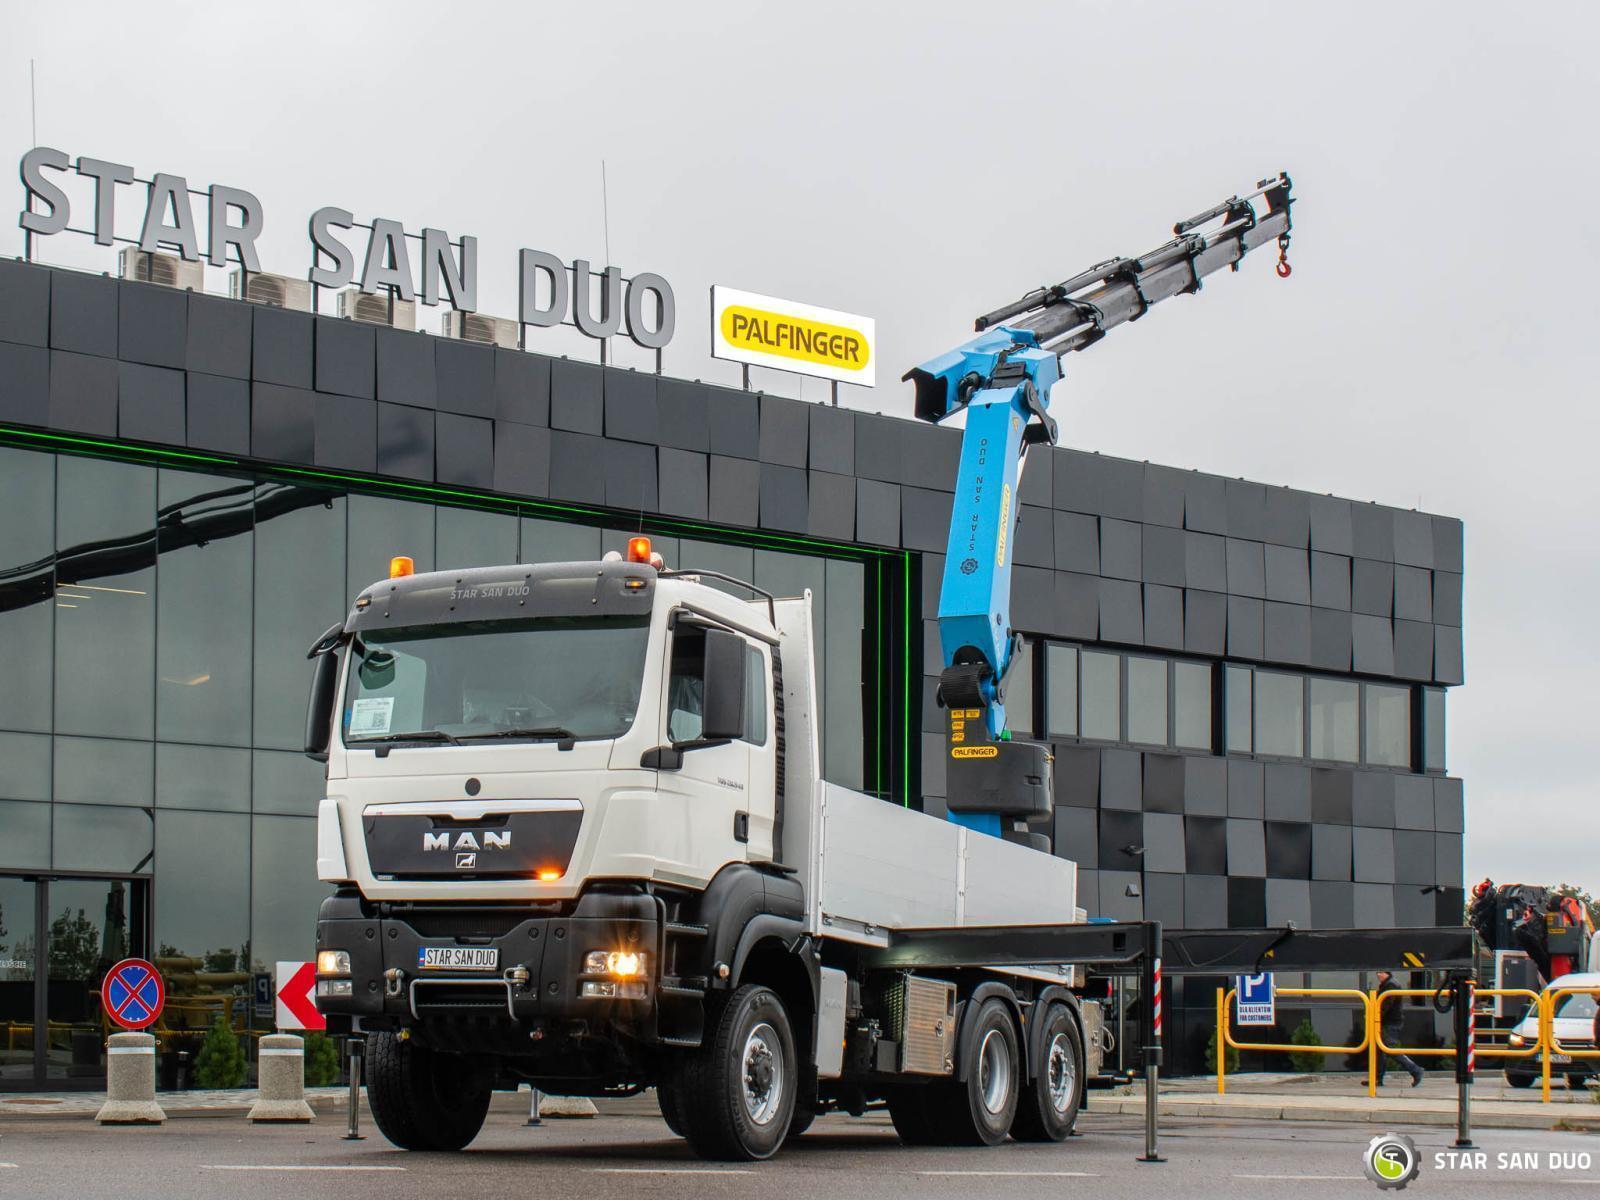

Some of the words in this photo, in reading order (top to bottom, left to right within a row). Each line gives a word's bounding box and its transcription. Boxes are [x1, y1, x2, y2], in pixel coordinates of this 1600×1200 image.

[20, 147, 264, 273] STAR
[309, 206, 477, 312] SAN
[519, 247, 676, 349] DUO
[732, 314, 859, 362] PALFINGER
[979, 438, 988, 465] DUO
[975, 476, 984, 504] SAN
[969, 514, 979, 552] STAR
[450, 589, 478, 600] STAR
[481, 587, 504, 598] SAN
[507, 585, 530, 596] DUO
[954, 748, 994, 756] PALFINGER
[423, 831, 512, 851] MAN
[426, 949, 452, 964] STAR
[454, 950, 474, 965] SAN
[475, 950, 496, 966] DUO
